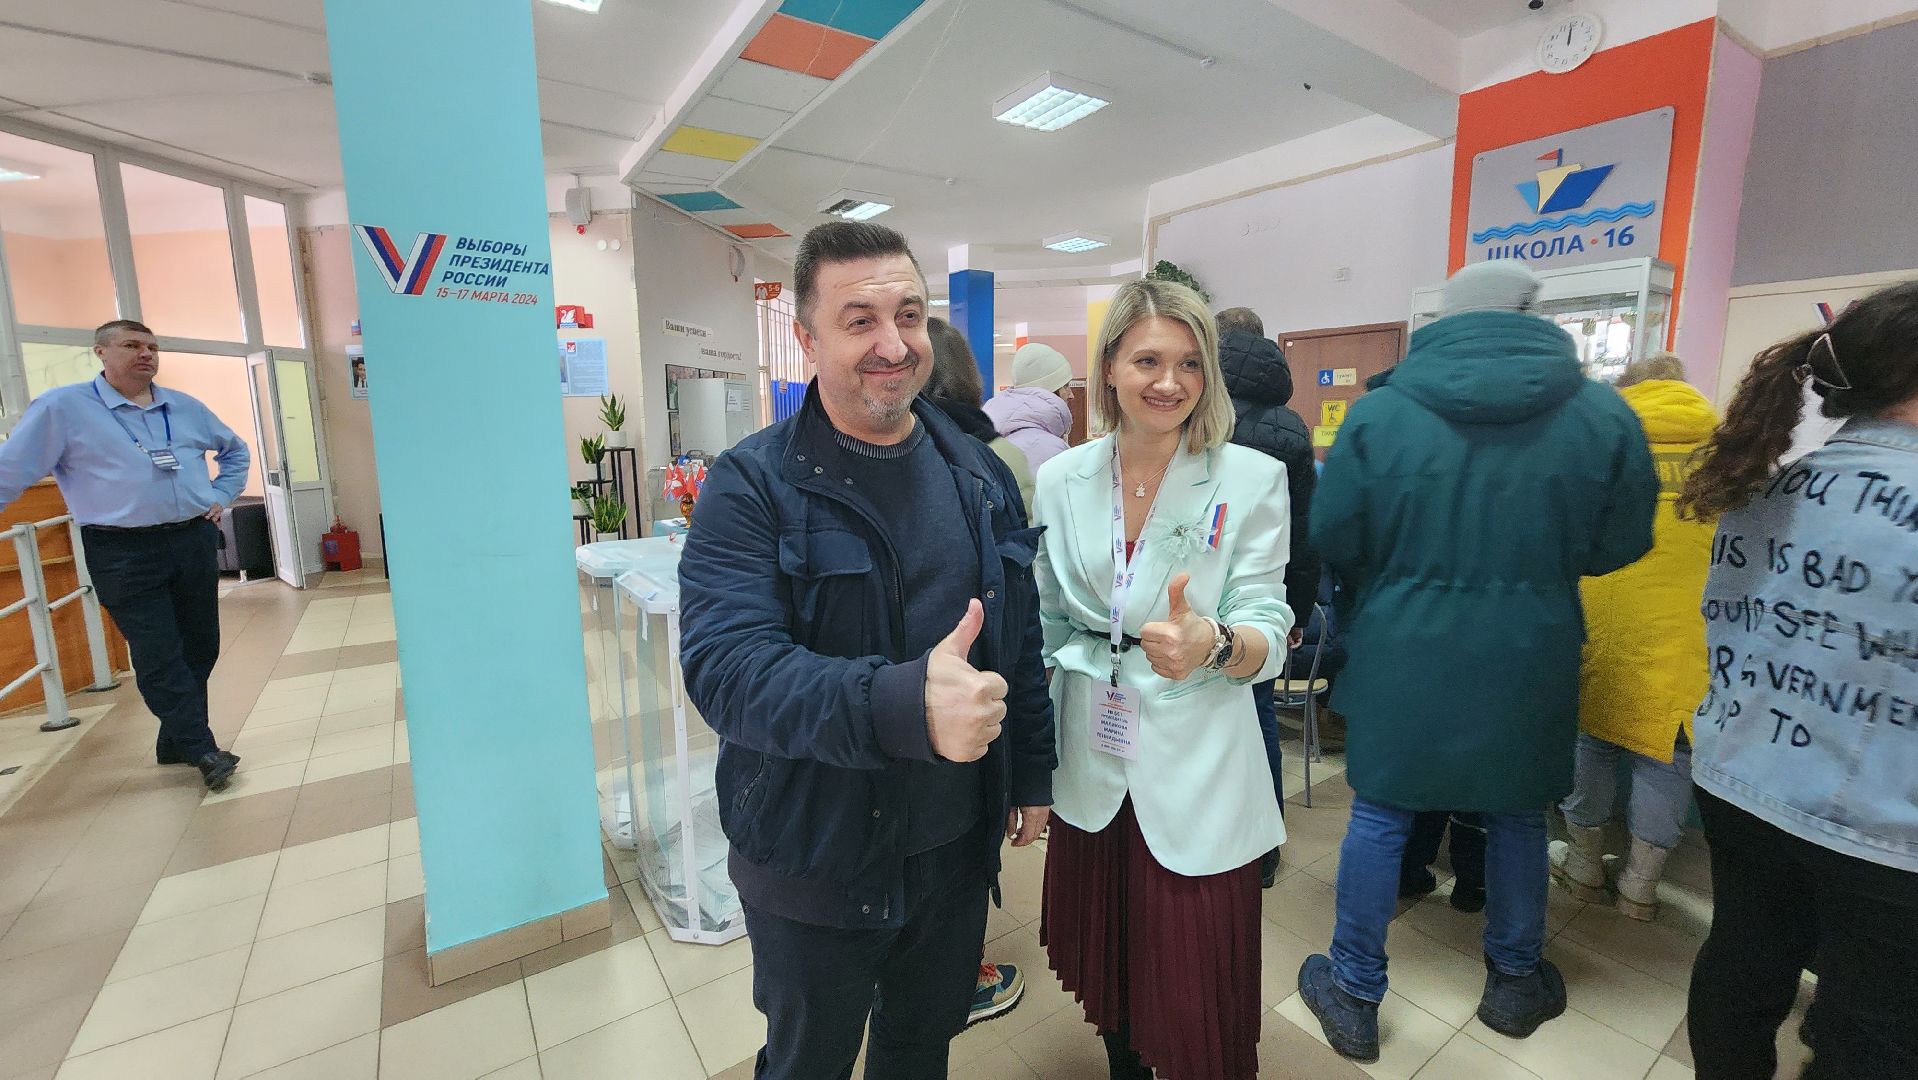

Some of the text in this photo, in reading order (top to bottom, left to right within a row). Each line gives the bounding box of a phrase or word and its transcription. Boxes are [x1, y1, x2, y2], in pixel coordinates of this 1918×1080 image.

[455, 236, 528, 256] ВЫБОРЫ
[1487, 225, 1635, 261] ШКОЛА 16
[448, 254, 550, 276] ПРЕЗИДЕНТА
[441, 270, 508, 288] РОССИИ
[470, 290, 509, 303] МАРТА
[511, 292, 539, 305] 2024
[1327, 404, 1340, 412] WC
[1768, 537, 1794, 575] IS
[1803, 549, 1872, 593] BAD
[1772, 600, 1838, 650] SEE
[1769, 707, 1812, 748] TO
